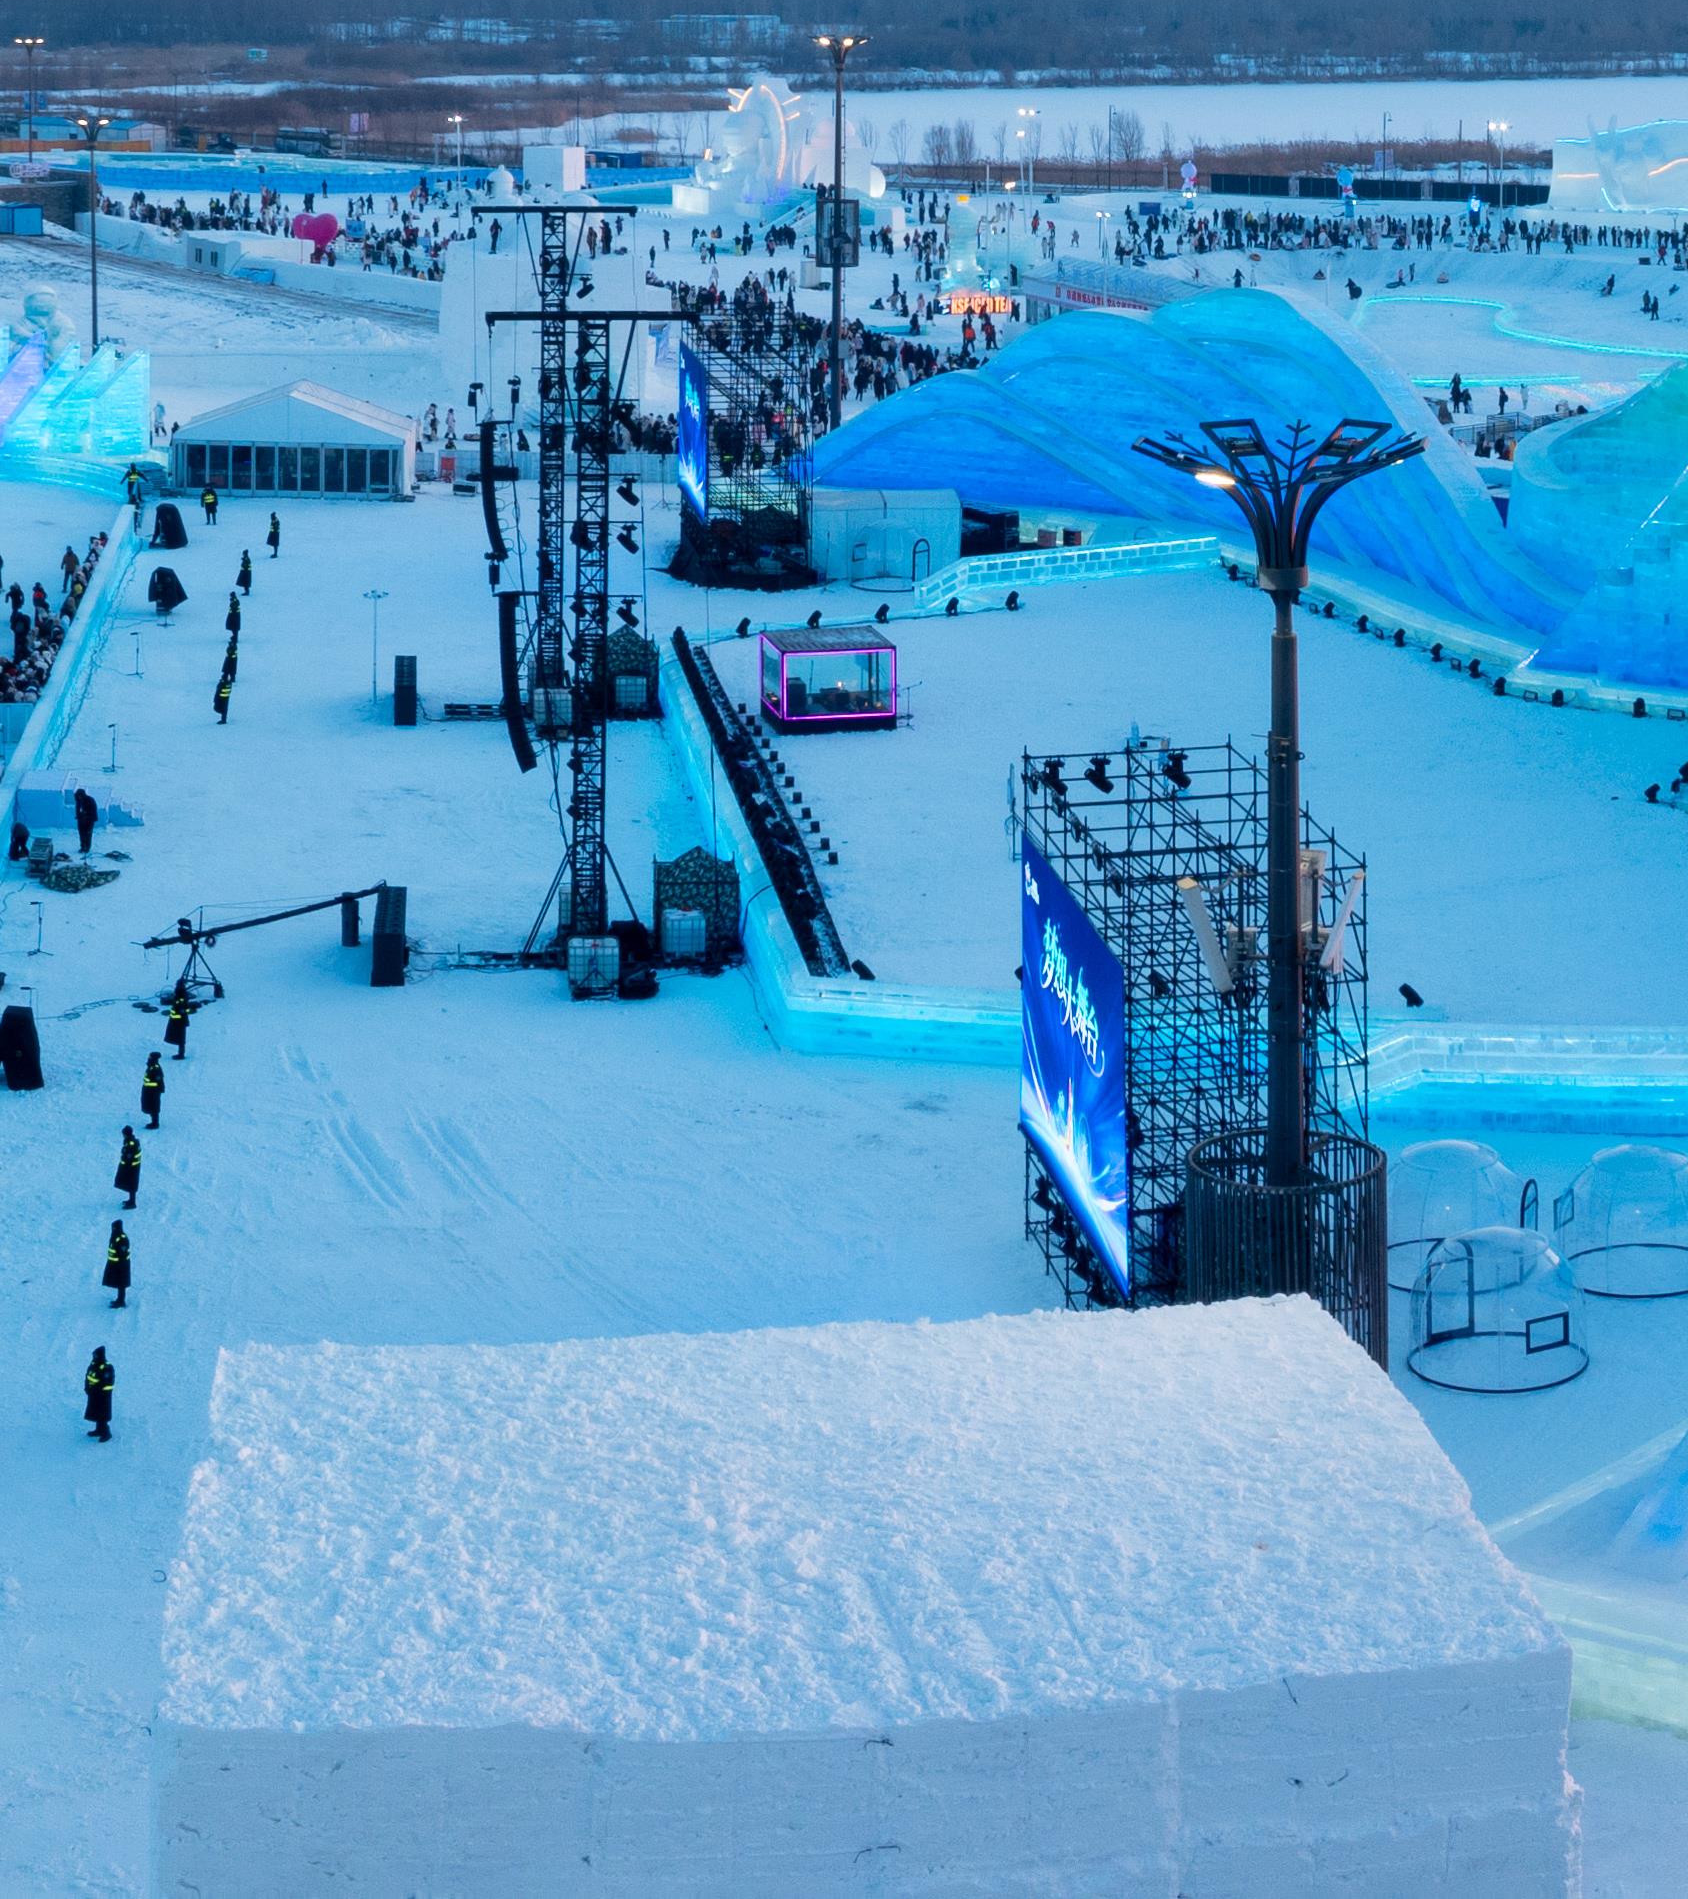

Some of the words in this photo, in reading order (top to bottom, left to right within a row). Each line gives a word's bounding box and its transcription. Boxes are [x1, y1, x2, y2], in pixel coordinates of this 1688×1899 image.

[1039, 917, 1102, 1071] 梦想大舞台
